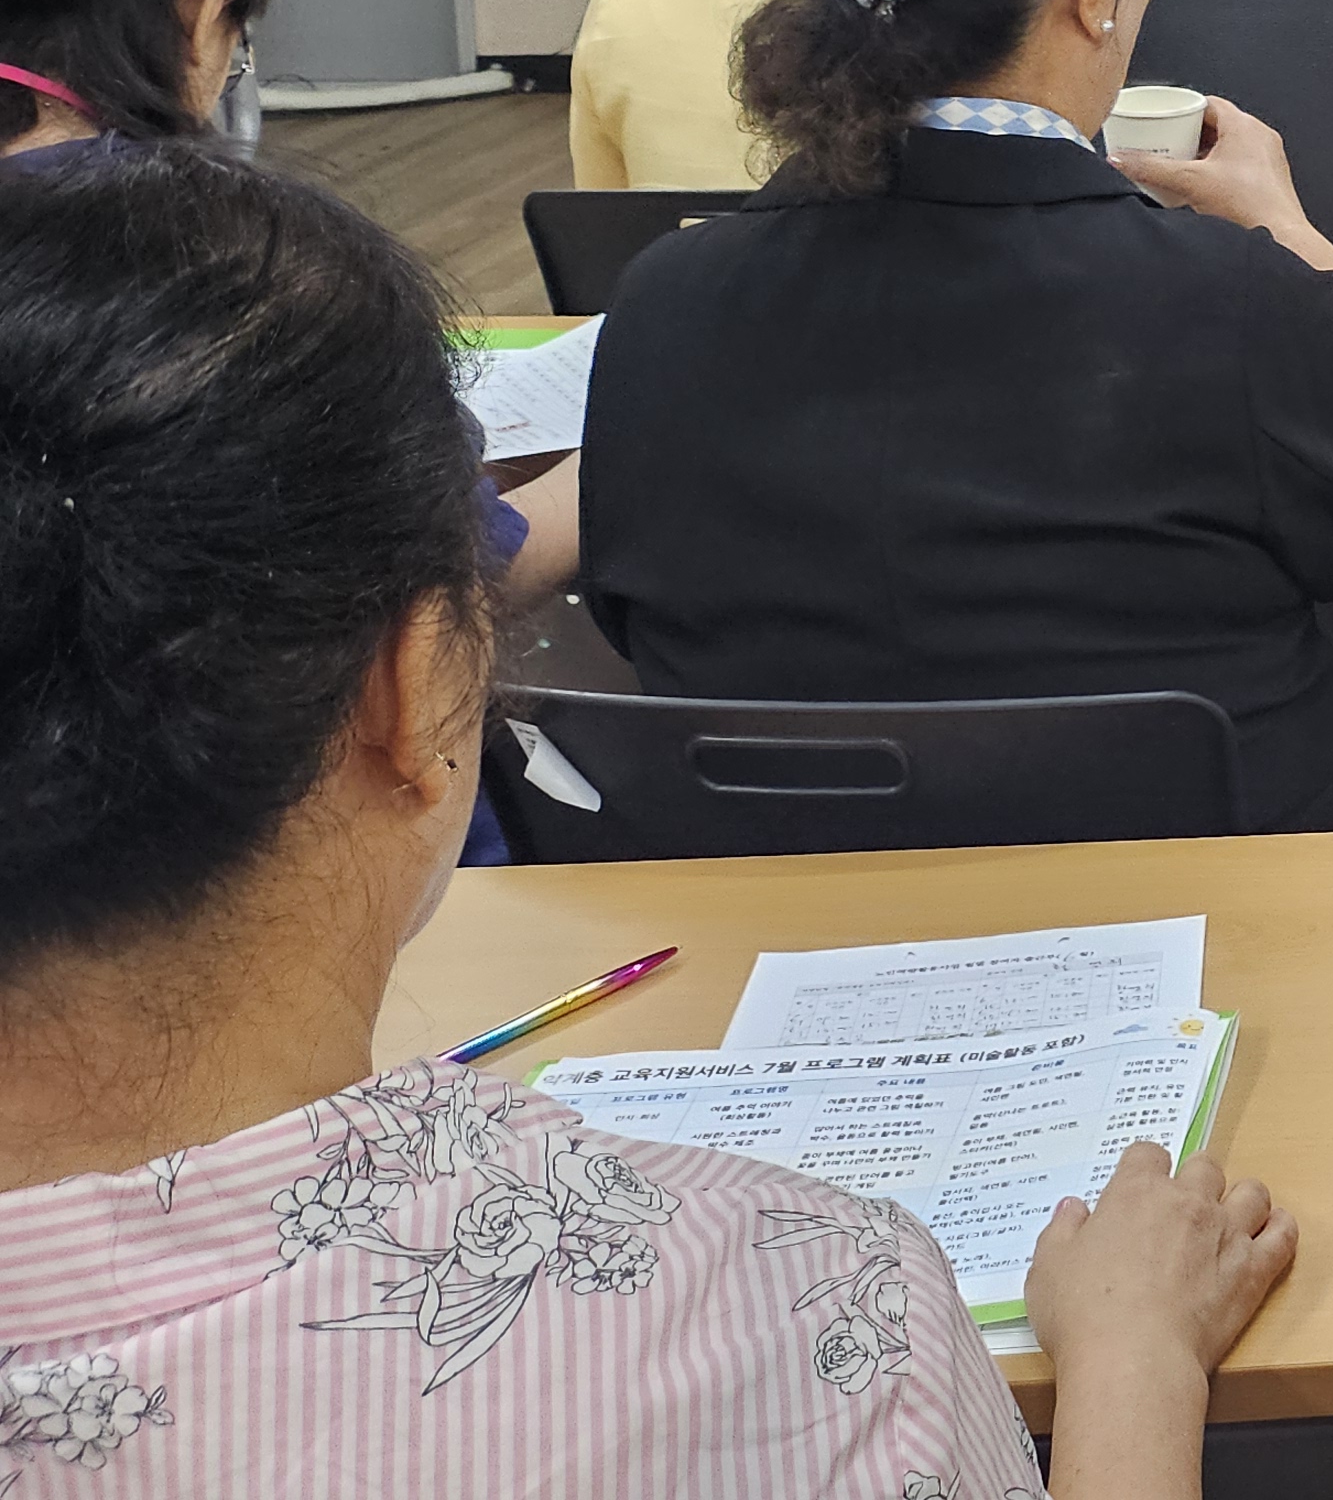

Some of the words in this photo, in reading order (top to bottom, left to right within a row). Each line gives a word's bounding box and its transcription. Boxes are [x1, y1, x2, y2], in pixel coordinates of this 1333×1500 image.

[609, 1063, 760, 1081] 교육지원서비스
[762, 1060, 798, 1074] 7월
[801, 1056, 887, 1071] 프로그램
[891, 1052, 953, 1067] 계획표
[959, 1044, 1038, 1063] (미술활동
[1042, 1034, 1085, 1050] 포함)
